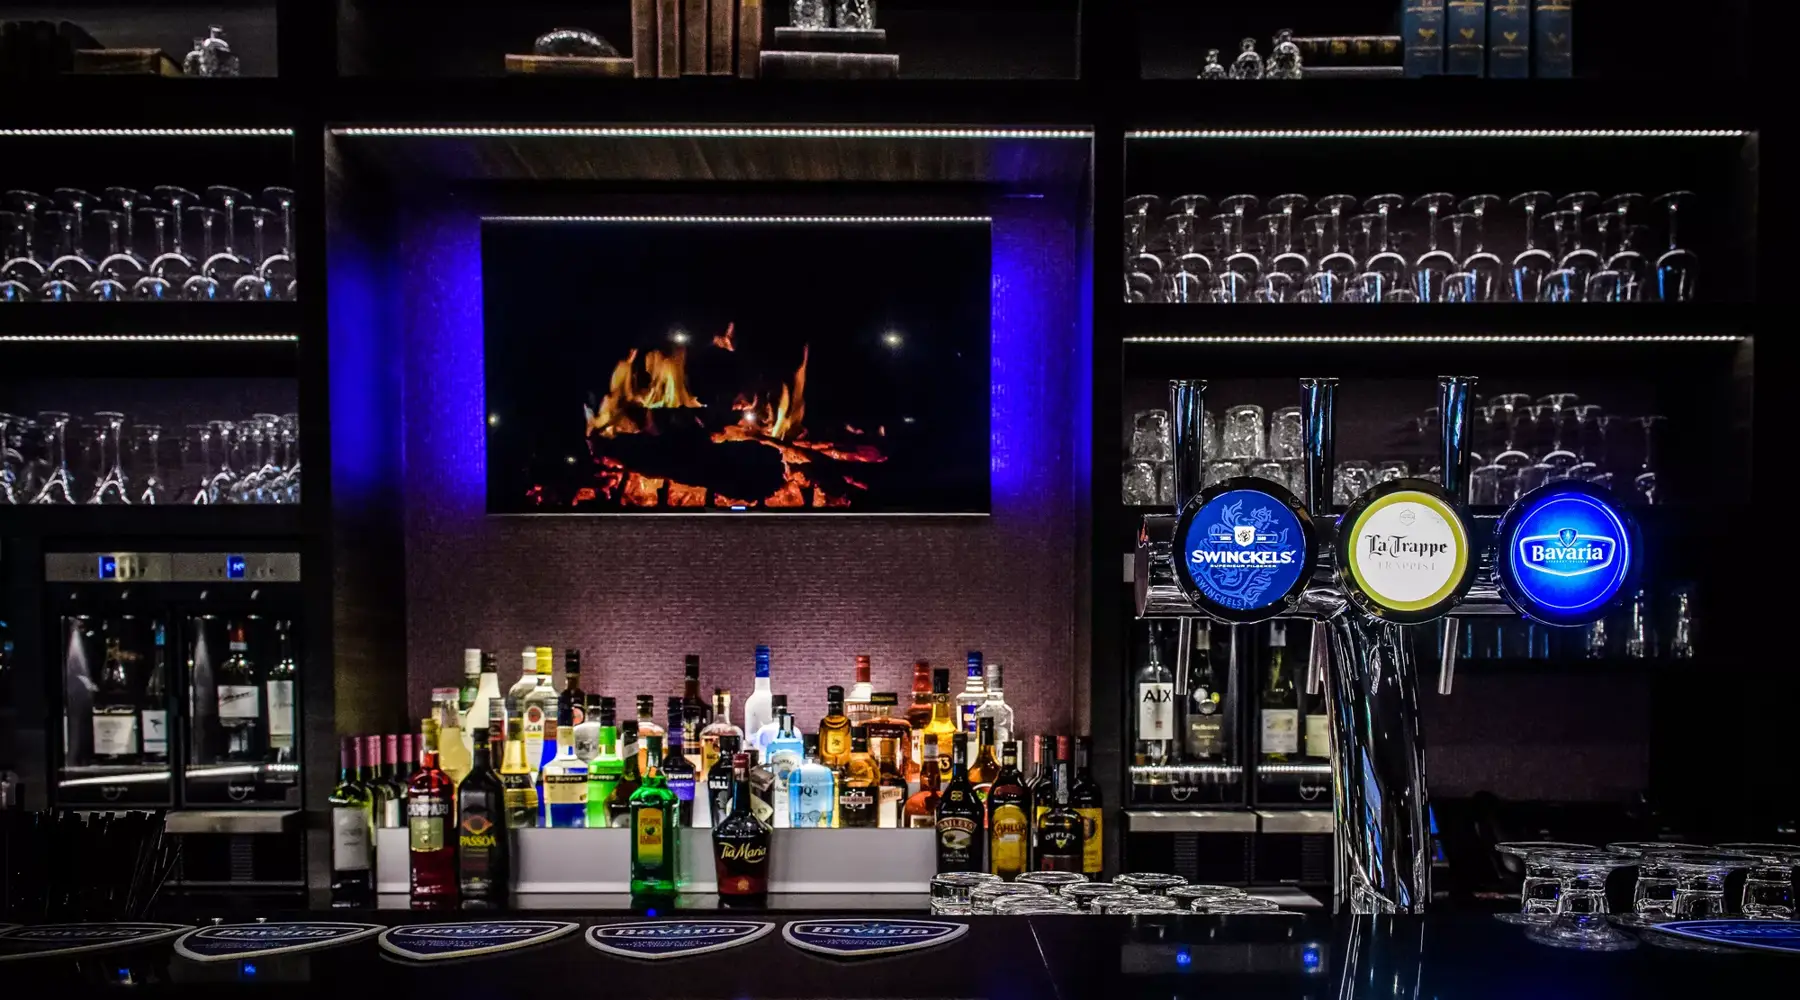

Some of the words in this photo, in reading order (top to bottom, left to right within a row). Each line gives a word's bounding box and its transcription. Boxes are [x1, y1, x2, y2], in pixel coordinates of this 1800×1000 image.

[1387, 534, 1449, 558] Trappe
[1532, 543, 1603, 562] Bavaria
[1143, 689, 1172, 703] AIX
[407, 803, 449, 817] CAMPARI
[718, 841, 737, 860] Tia
[733, 842, 767, 863] Maria
[615, 928, 736, 936] Bavaria
[808, 926, 930, 935] Bavaria
